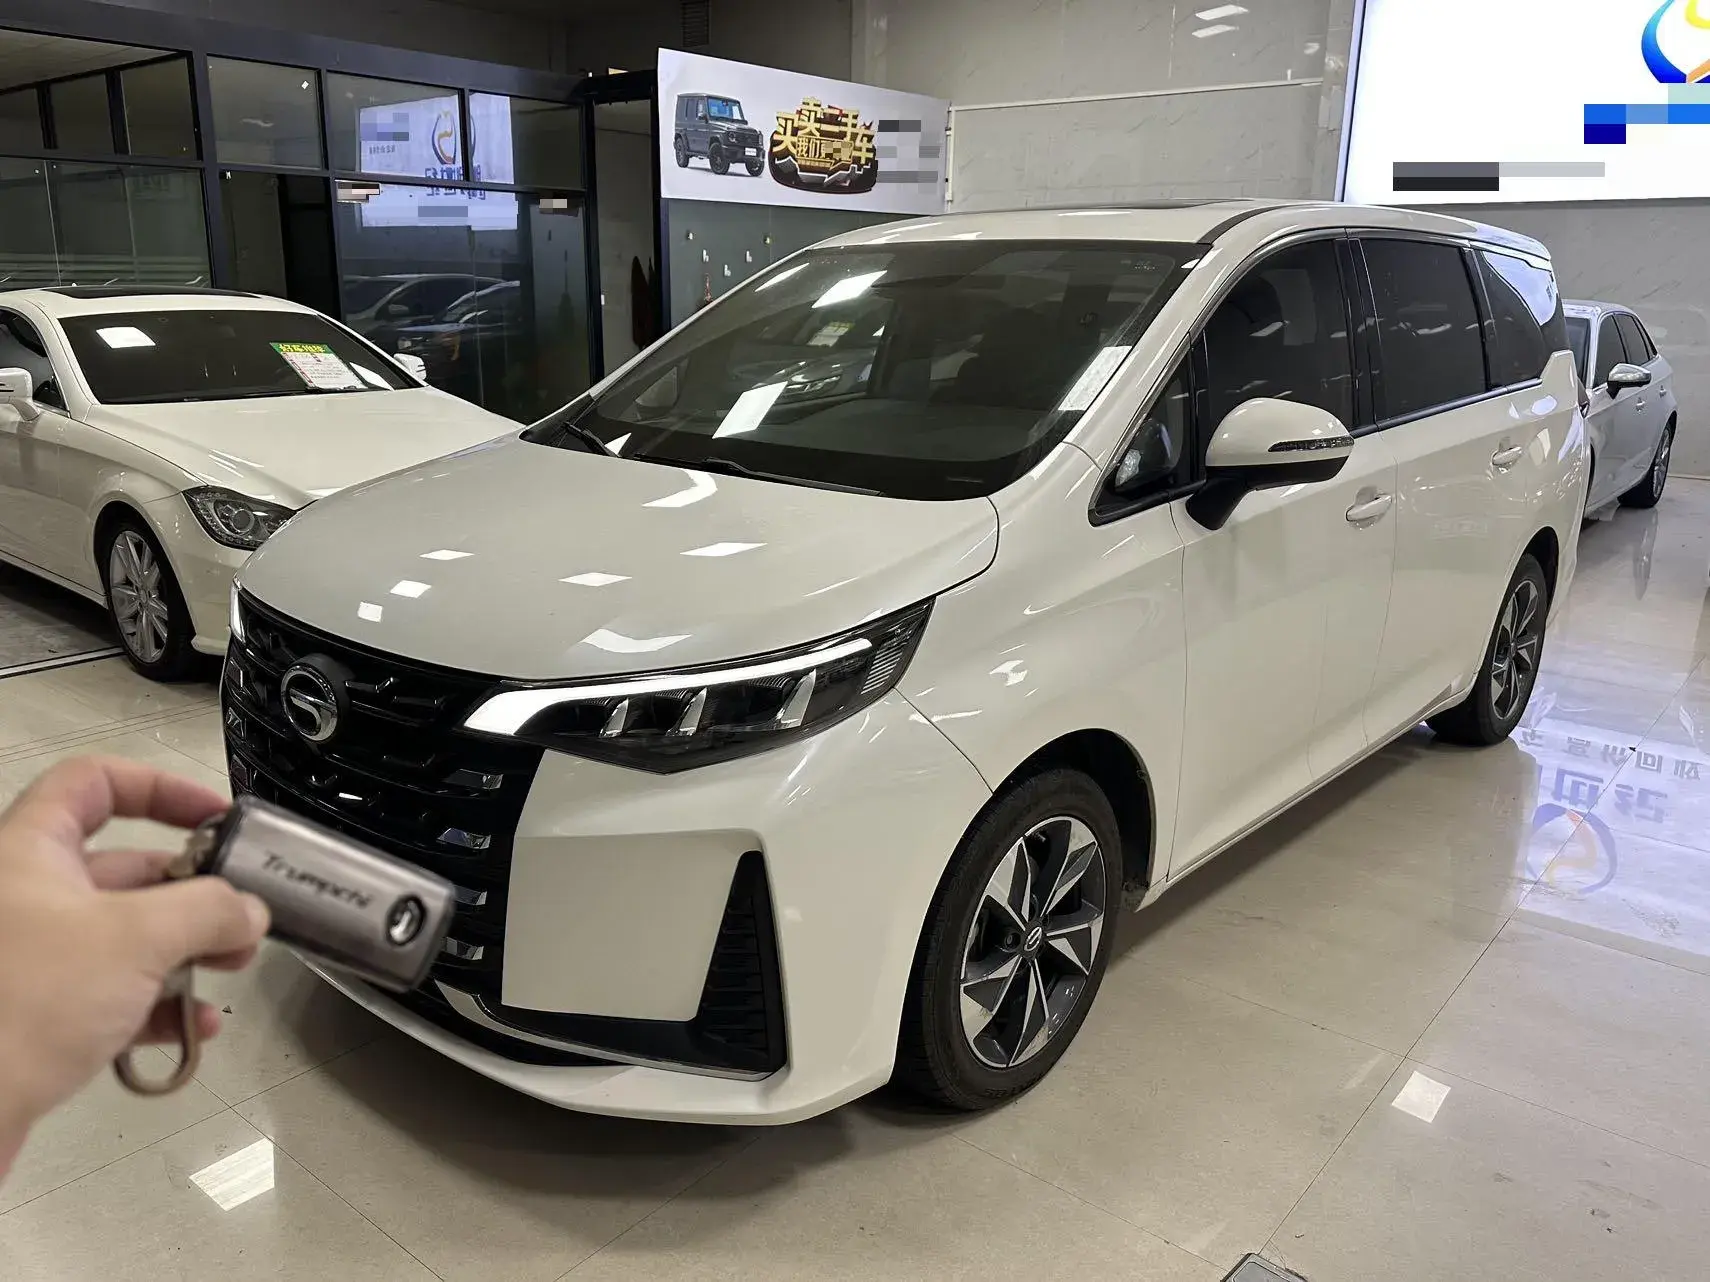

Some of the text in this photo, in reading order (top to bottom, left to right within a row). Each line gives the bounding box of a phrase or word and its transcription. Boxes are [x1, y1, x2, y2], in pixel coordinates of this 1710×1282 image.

[772, 96, 875, 165] 买卖二手车
[263, 853, 373, 908] Trumpchi
